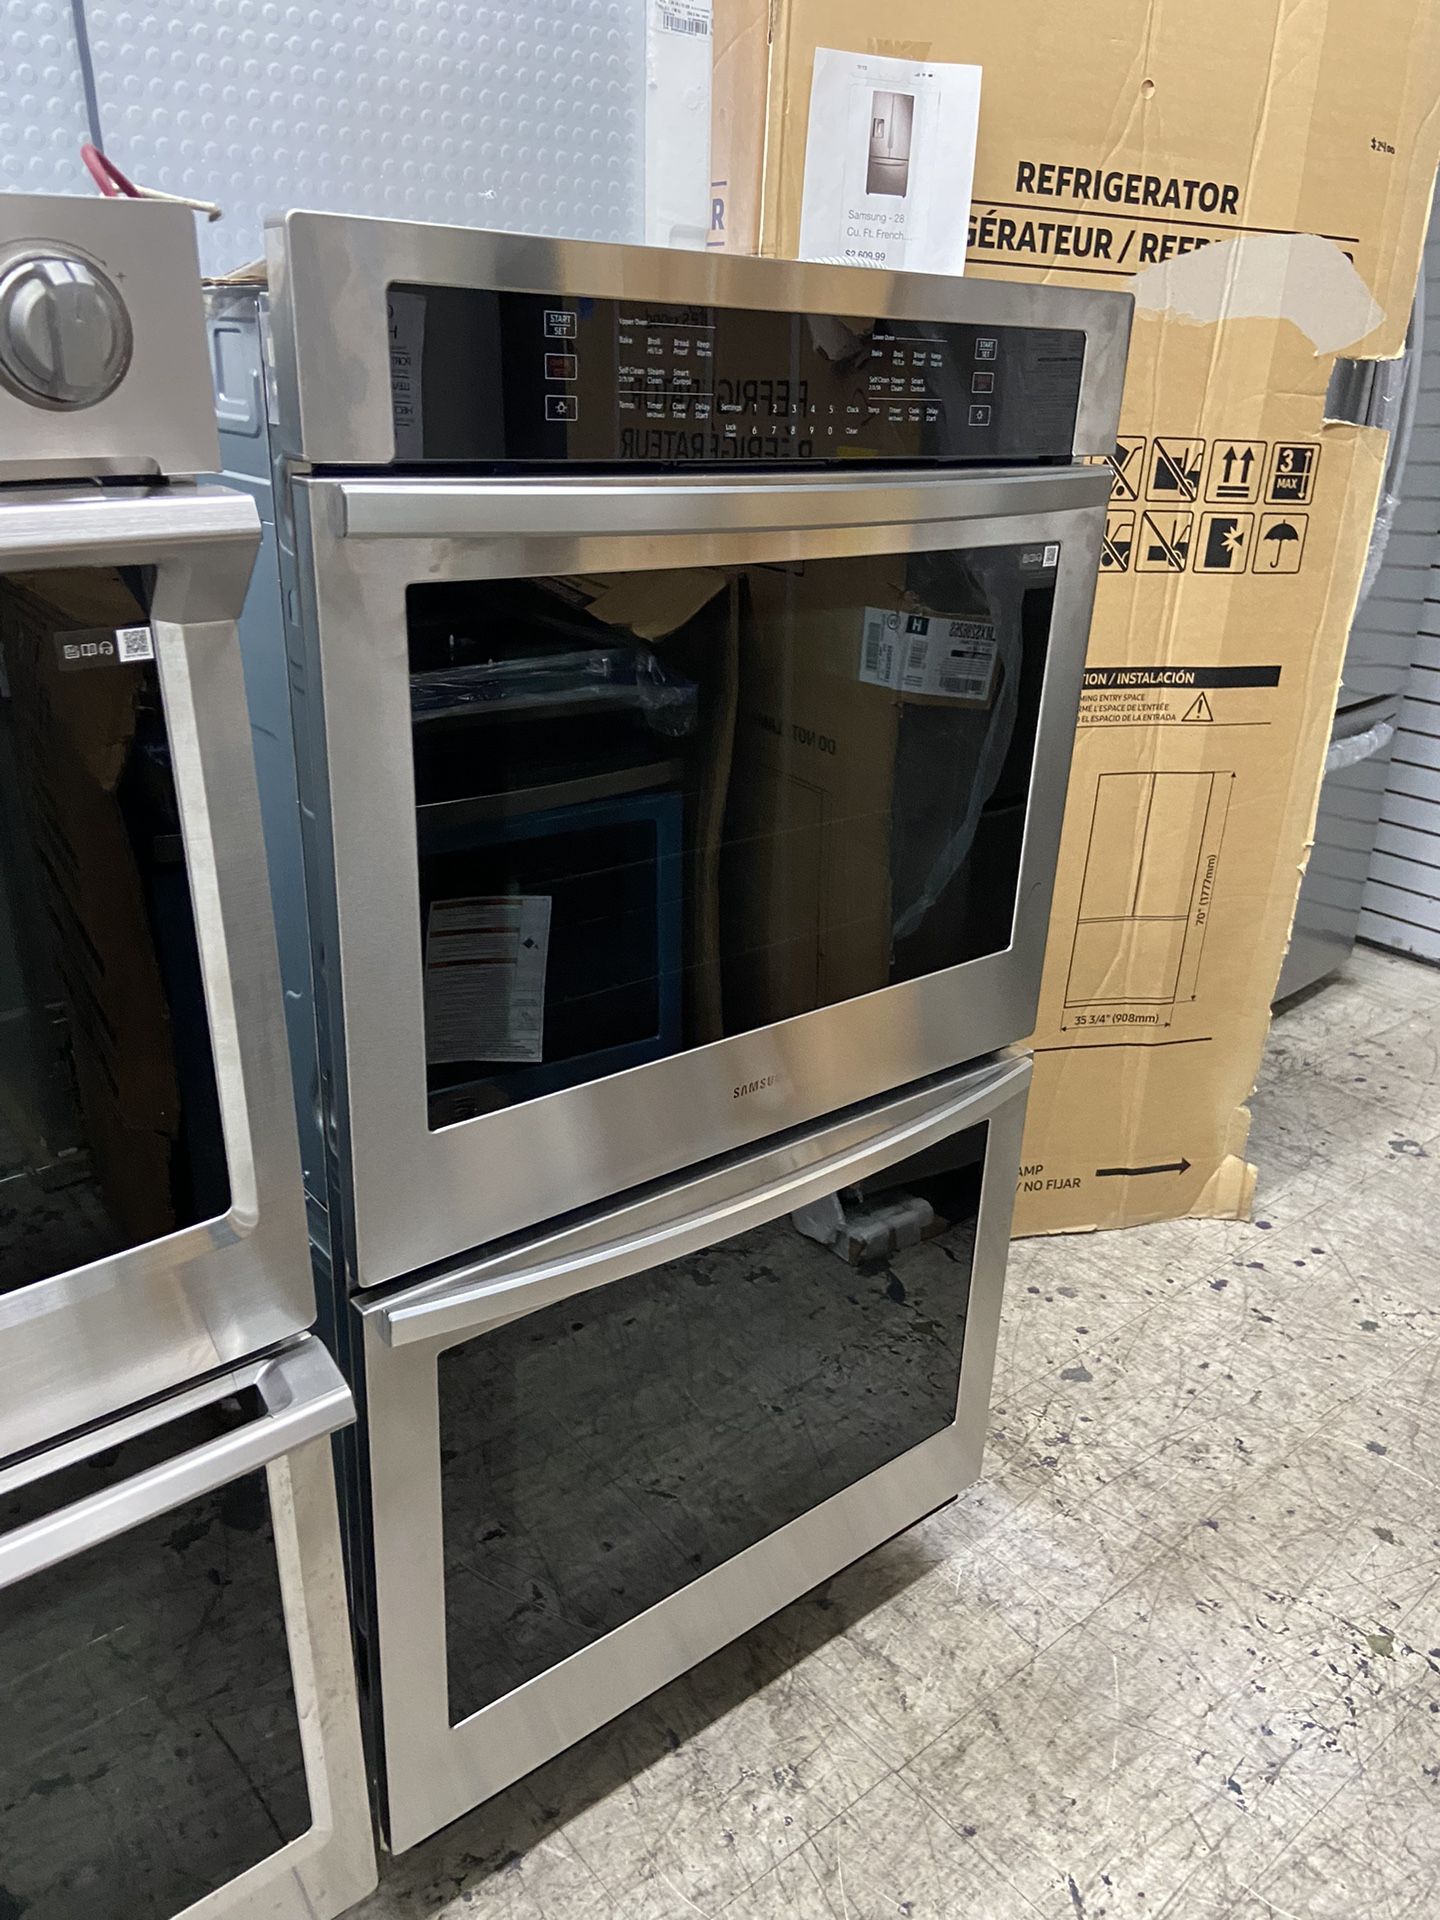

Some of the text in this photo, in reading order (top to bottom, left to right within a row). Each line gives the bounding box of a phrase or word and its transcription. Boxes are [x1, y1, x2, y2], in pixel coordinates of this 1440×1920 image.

[1016, 160, 1239, 215] REFRIGERATOR
[848, 209, 886, 224] Samsung
[894, 213, 904, 224] 28
[846, 226, 862, 237] Cu.
[863, 228, 874, 238] Ft.
[966, 208, 1112, 259] GÉRATEUR
[845, 249, 886, 262] $2609.99
[550, 314, 571, 323] START
[554, 326, 567, 335] SET
[618, 336, 633, 344] Bake
[673, 338, 690, 347] Bread
[630, 366, 644, 375] Clean
[673, 368, 690, 376] Smart
[647, 376, 663, 384] Clean
[673, 377, 692, 385] Control
[647, 402, 664, 410] Timer
[672, 402, 686, 410] Cook
[695, 402, 710, 412] Delay
[720, 404, 742, 412] Settings
[772, 404, 777, 414] 2
[792, 404, 797, 413] 3
[810, 404, 816, 413] 4
[828, 405, 834, 414] 5
[752, 426, 758, 434] 6
[772, 426, 776, 434] 7
[790, 426, 796, 435] 8
[809, 426, 814, 434] 9
[828, 426, 832, 435] 0
[1280, 449, 1294, 473] 3
[1276, 478, 1298, 489] MAX
[1083, 670, 1195, 686] ION / INSTALACIÓN
[1099, 694, 1121, 702] ENTRY
[1123, 693, 1145, 701] SPACE
[1094, 704, 1125, 712] L'ESPACE
[1126, 704, 1136, 712] DE
[1091, 714, 1120, 722] ESPACIO
[1122, 714, 1132, 722] DE
[1199, 854, 1217, 906] (1777mm)
[1074, 1016, 1086, 1026] 35
[1112, 1013, 1160, 1024] (908mm)
[733, 1074, 781, 1099] SAMSU
[1018, 1164, 1044, 1177] AMP
[1023, 1180, 1043, 1192] NO
[1046, 1178, 1082, 1191] FIJAR
